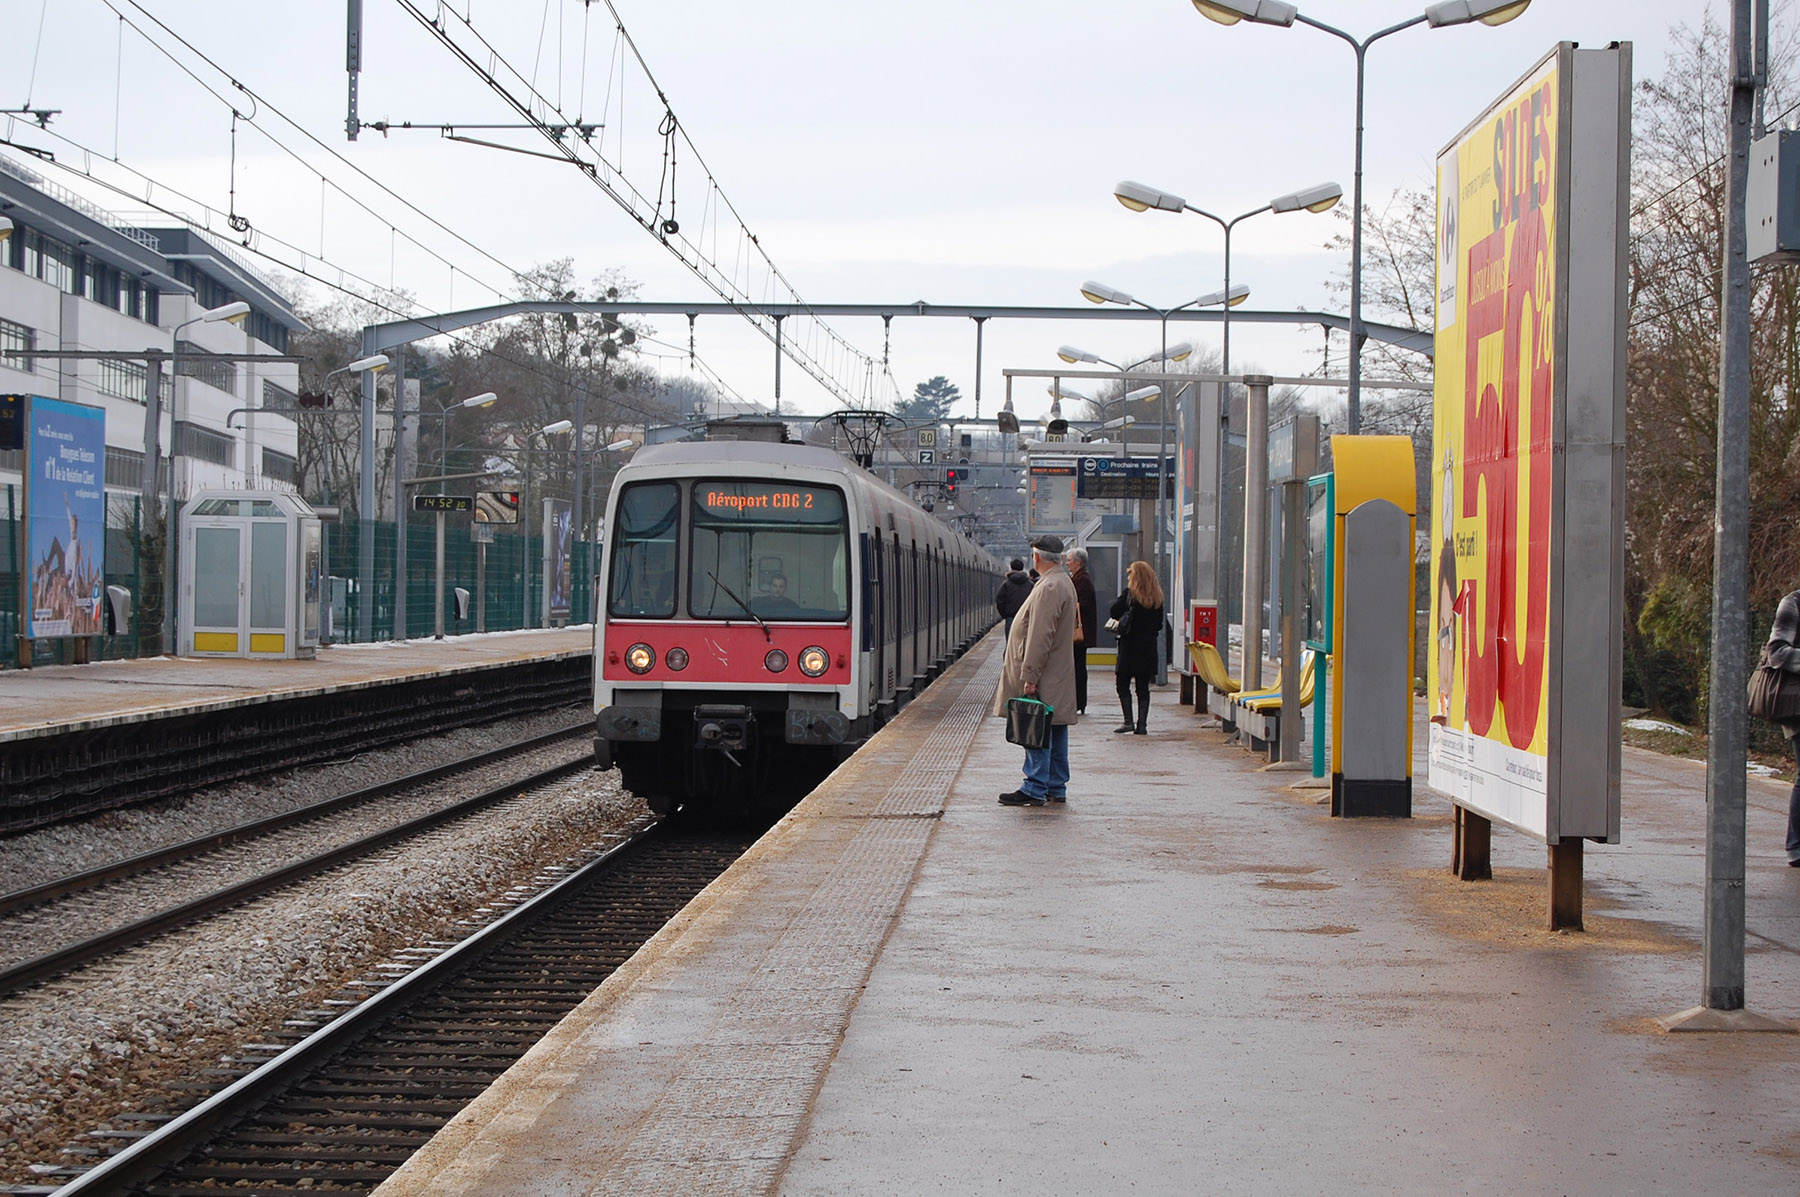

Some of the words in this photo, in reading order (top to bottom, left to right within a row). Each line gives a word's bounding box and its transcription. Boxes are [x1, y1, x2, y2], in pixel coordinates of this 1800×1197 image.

[1492, 81, 1551, 232] SOLDES
[920, 432, 933, 443] 80
[921, 452, 931, 463] Z
[1110, 461, 1140, 469] Prochains
[1141, 461, 1159, 469] trains
[424, 498, 435, 507] 14
[439, 498, 453, 508] 52
[707, 491, 769, 511] Aéroport
[772, 493, 800, 508] CDG
[804, 493, 813, 508] 2
